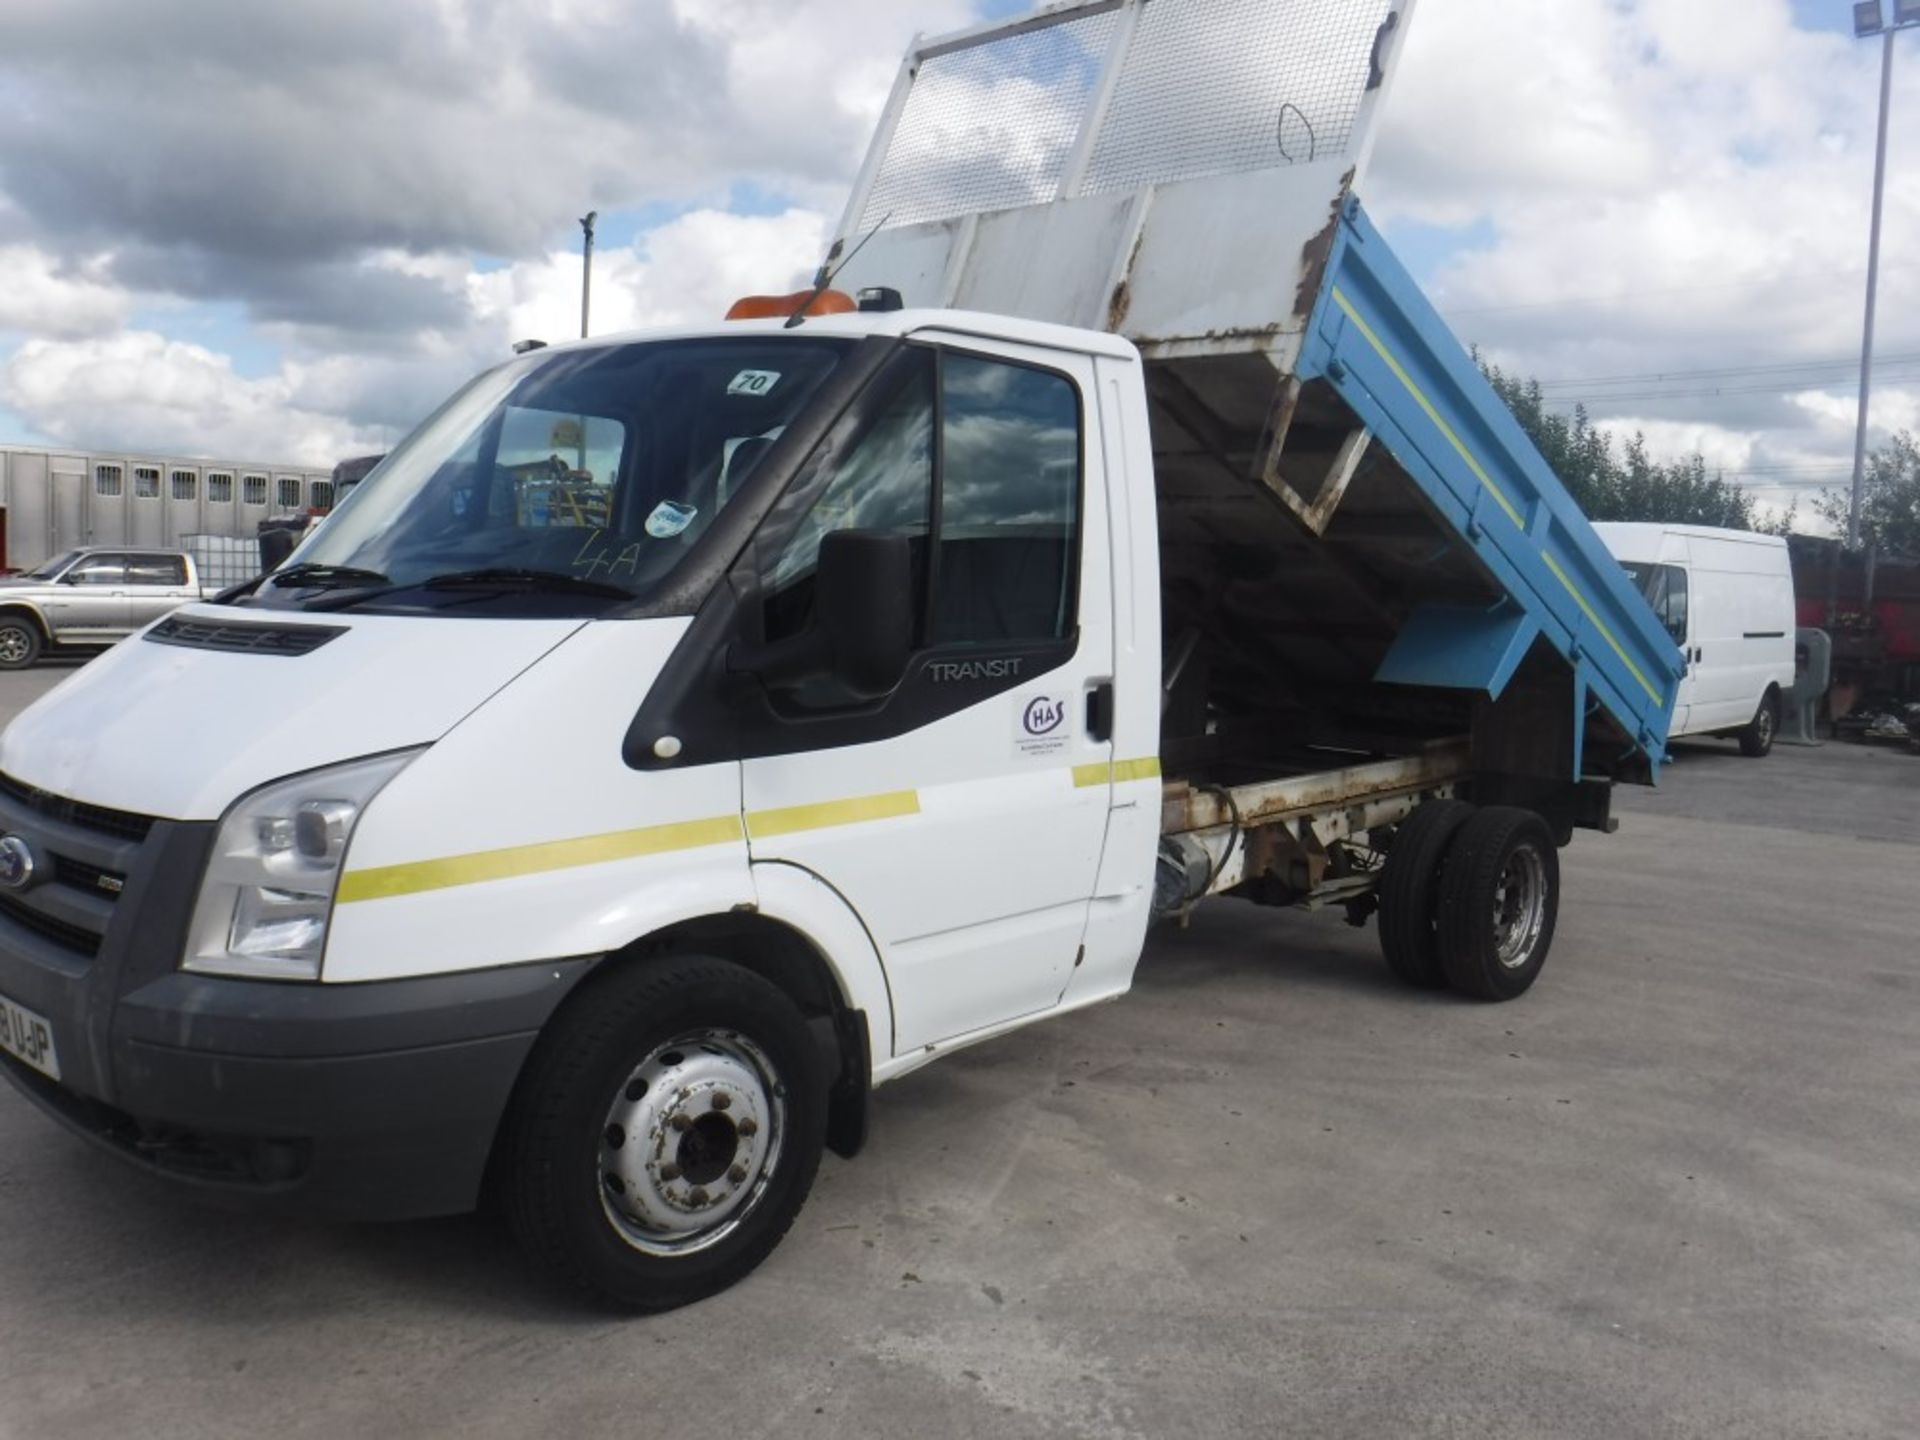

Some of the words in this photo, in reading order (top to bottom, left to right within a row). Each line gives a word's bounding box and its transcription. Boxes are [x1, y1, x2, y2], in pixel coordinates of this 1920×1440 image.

[738, 374, 767, 391] 70
[572, 529, 640, 579] 4A
[929, 658, 1022, 682] TRANSIT
